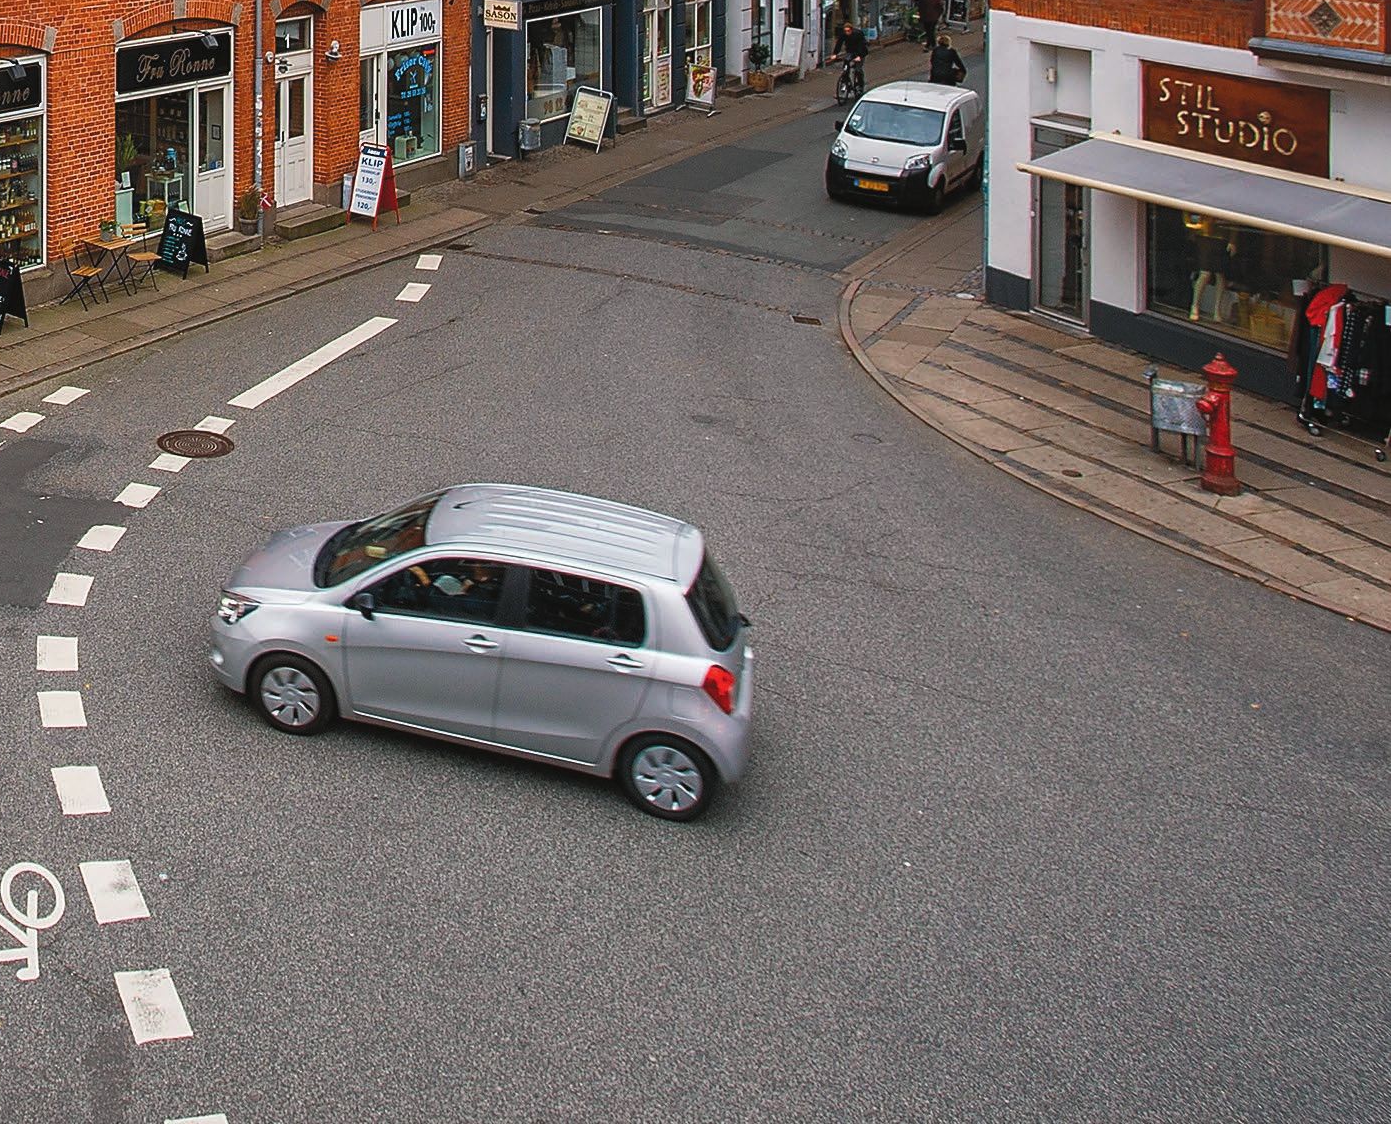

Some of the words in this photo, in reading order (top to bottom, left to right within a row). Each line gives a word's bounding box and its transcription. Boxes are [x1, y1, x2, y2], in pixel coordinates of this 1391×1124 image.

[485, 9, 517, 20] SASON
[391, 7, 417, 39] KLIP
[284, 33, 290, 49] 1
[1160, 77, 1220, 111] STIL
[361, 157, 383, 167] KLIP
